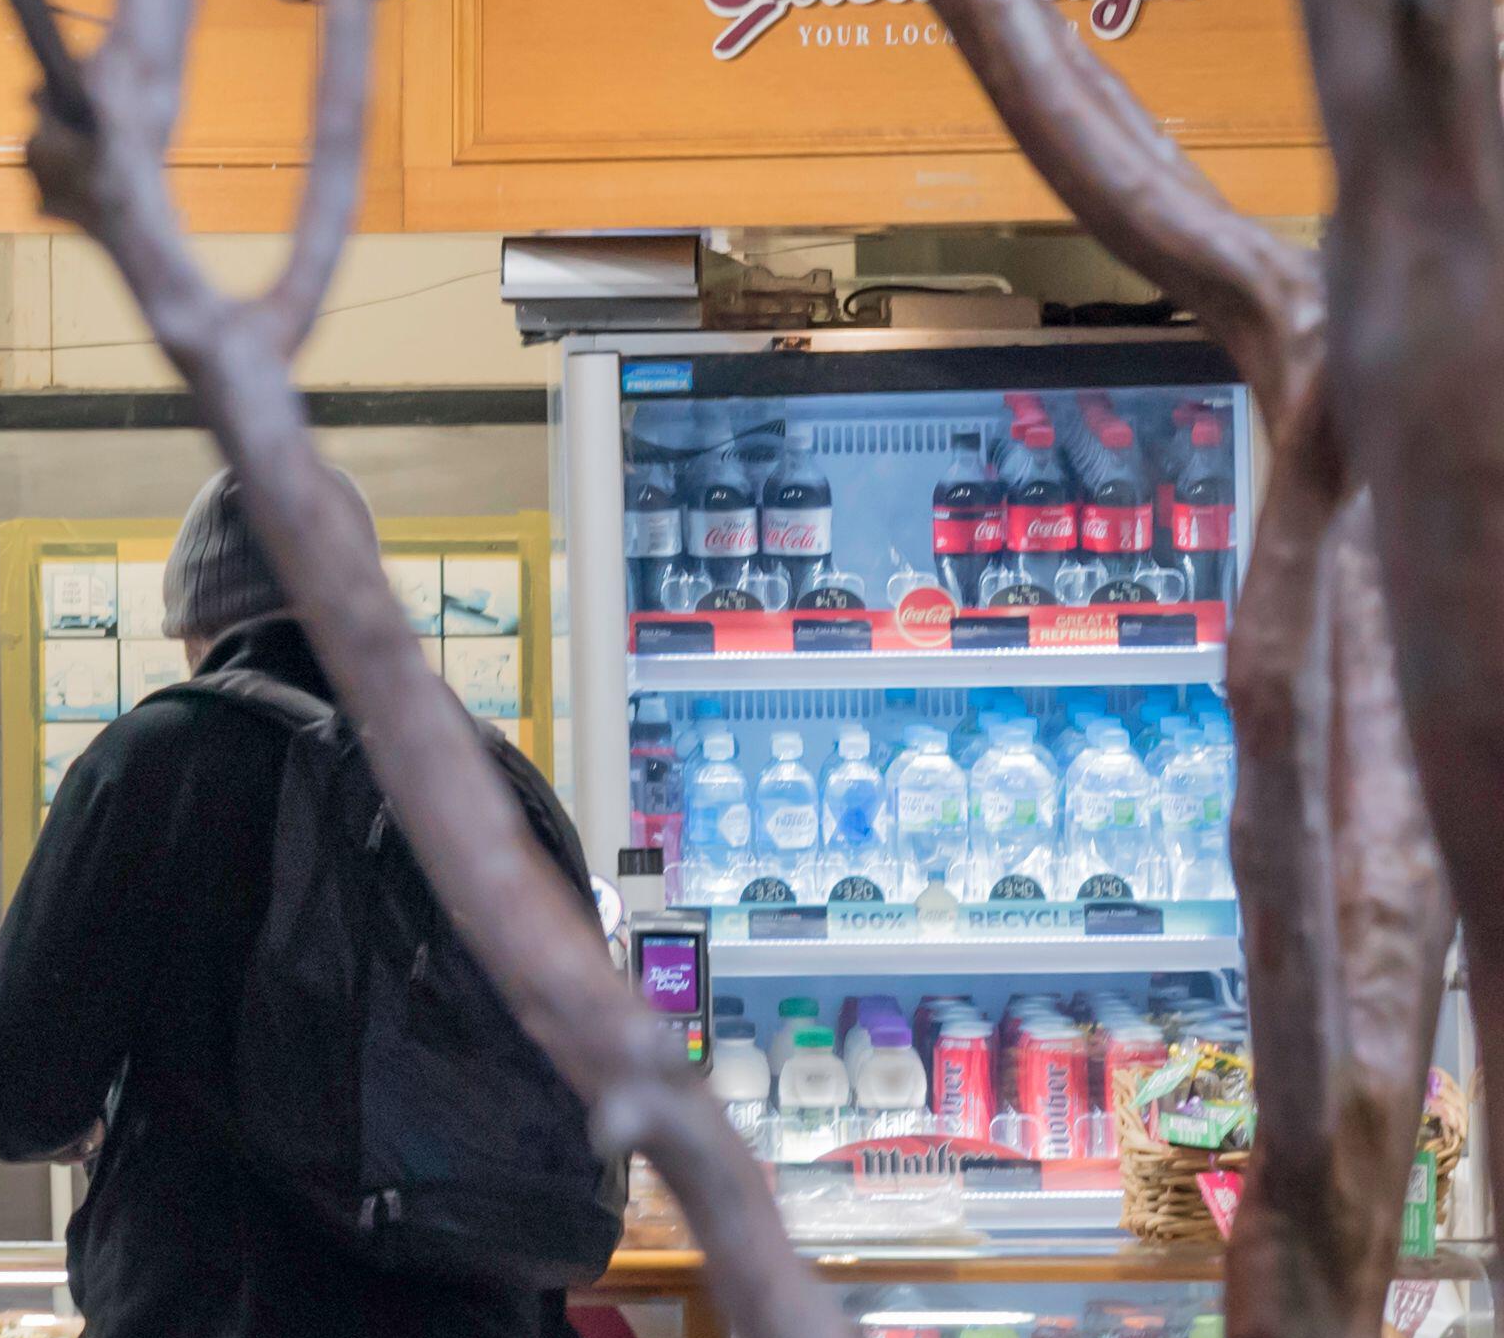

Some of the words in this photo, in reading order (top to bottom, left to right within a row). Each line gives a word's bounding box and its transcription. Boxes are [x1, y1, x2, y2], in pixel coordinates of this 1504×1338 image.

[798, 24, 860, 46] YOUR
[885, 24, 958, 46] LOCA
[1055, 614, 1105, 628] GREAT
[839, 912, 905, 930] 100%
[969, 911, 1083, 929] RECYCLE
